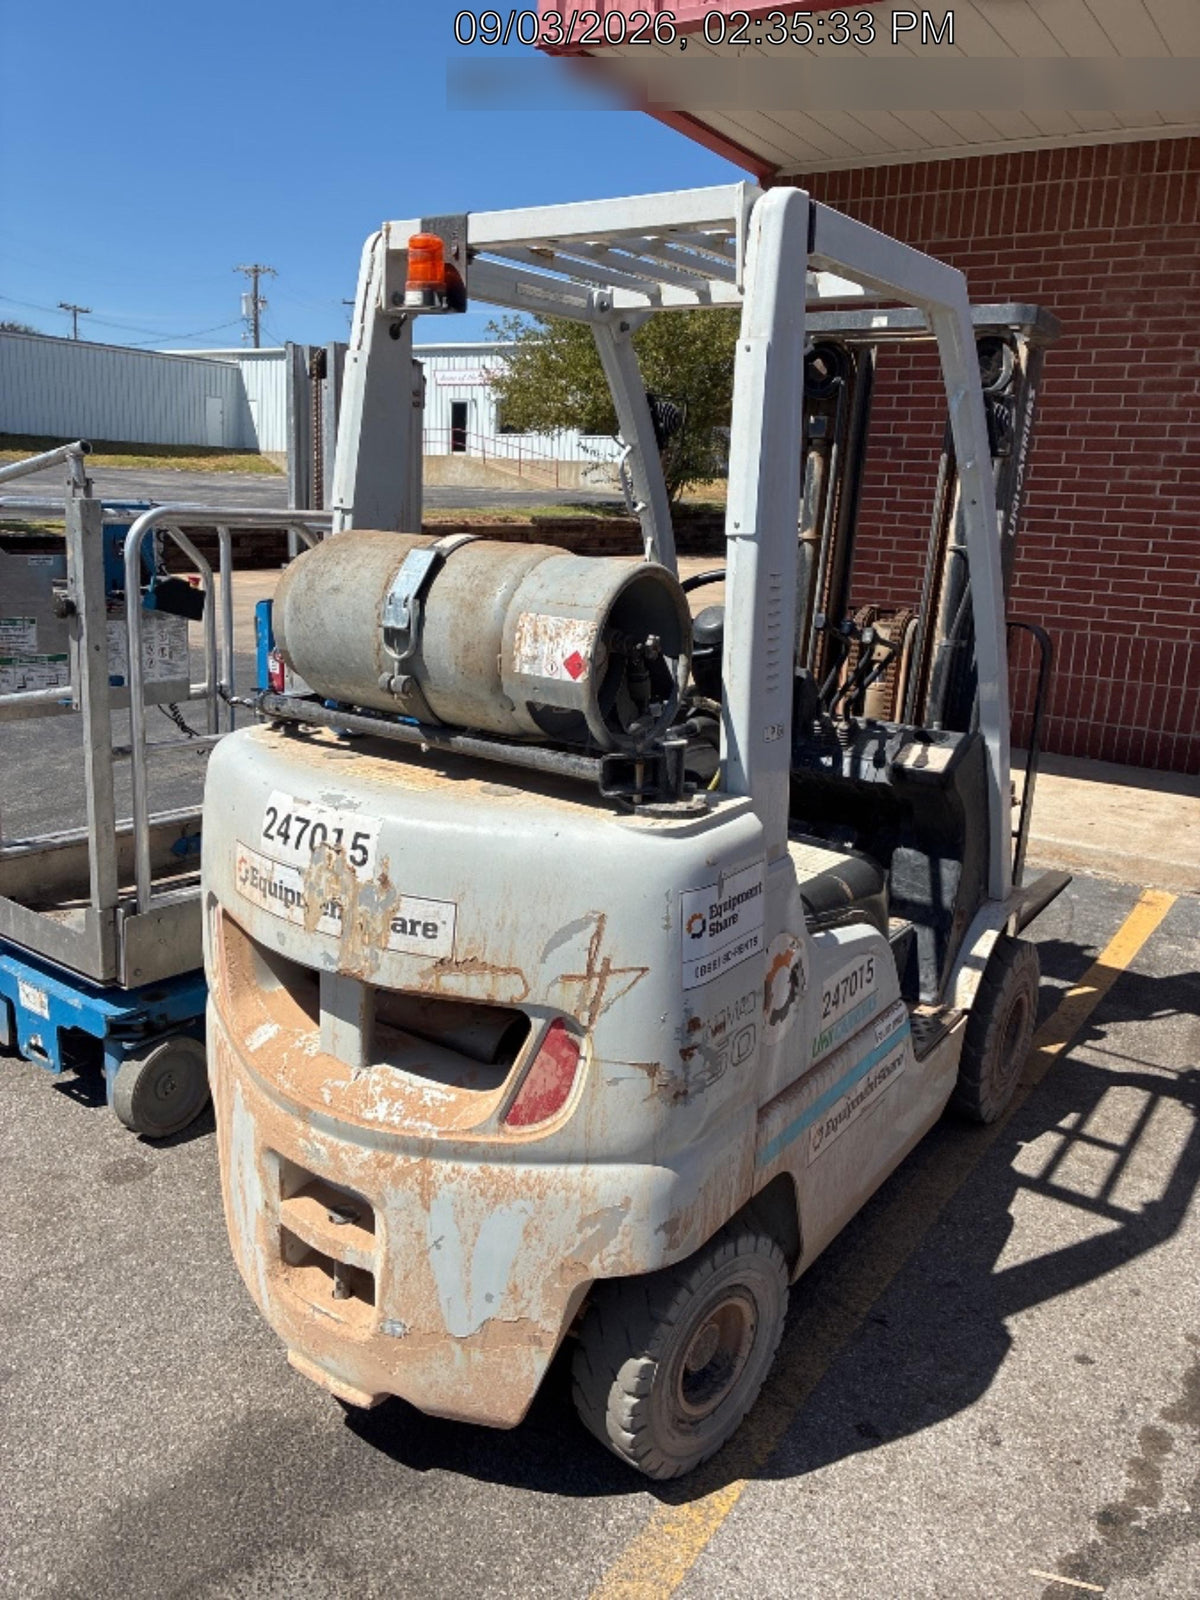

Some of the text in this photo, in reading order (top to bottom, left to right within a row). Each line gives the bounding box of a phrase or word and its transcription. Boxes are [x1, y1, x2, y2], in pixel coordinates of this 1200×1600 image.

[262, 806, 371, 867] 247015
[708, 912, 739, 937] Share
[709, 881, 762, 919] Equipment
[822, 957, 874, 1019] 247015
